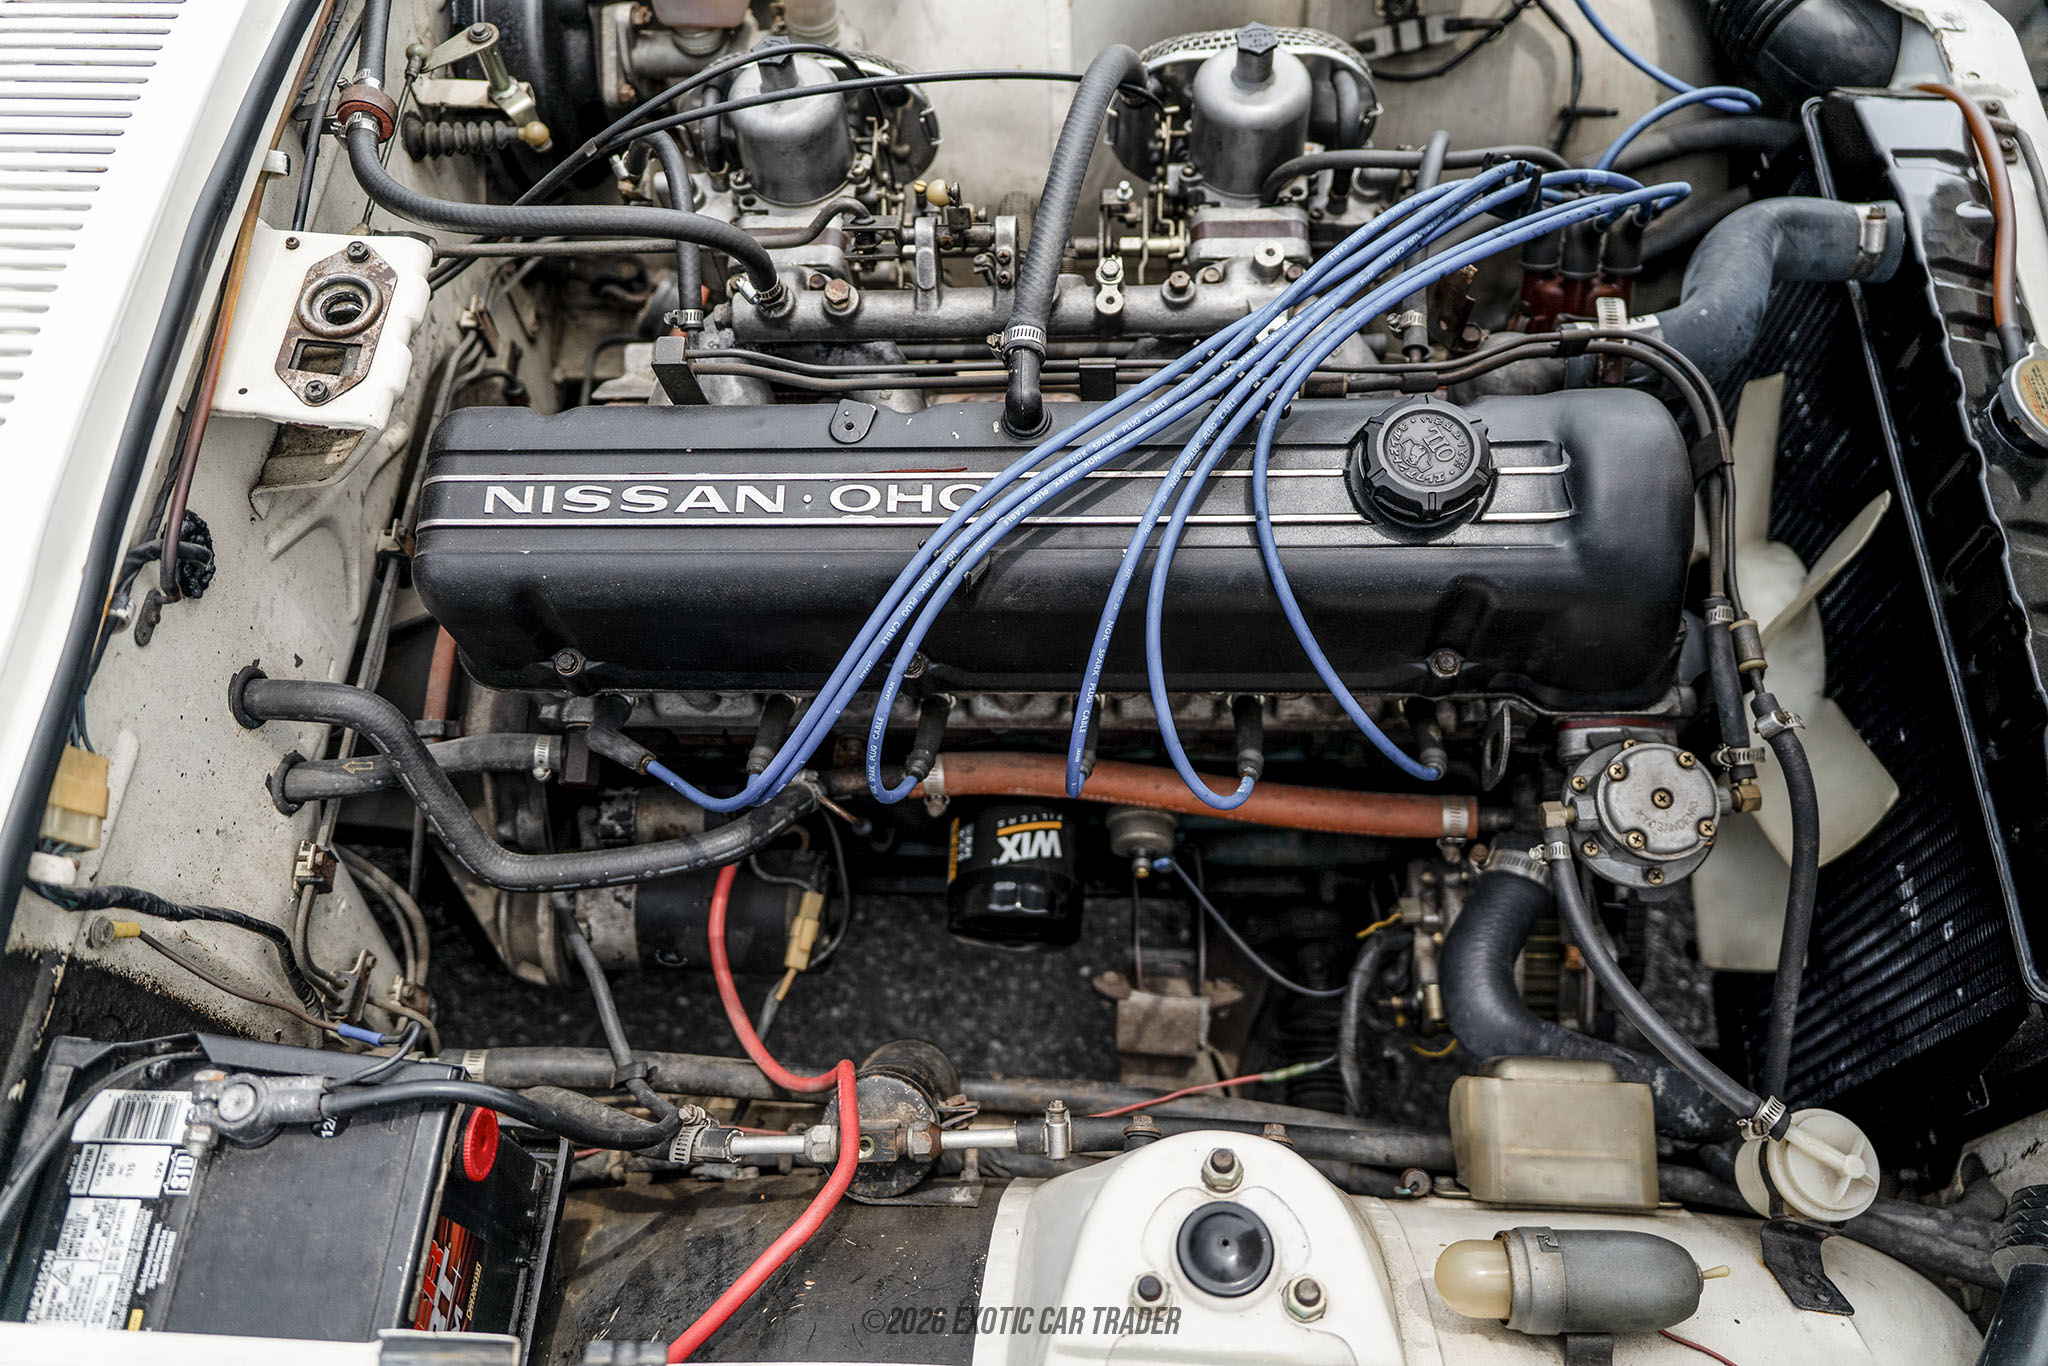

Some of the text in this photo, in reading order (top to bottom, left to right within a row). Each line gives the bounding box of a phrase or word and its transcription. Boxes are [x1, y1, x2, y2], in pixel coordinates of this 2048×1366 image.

[1327, 244, 1349, 263] CABLE
[1237, 346, 1259, 366] SPARK
[1262, 331, 1280, 347] PLUG
[1281, 313, 1304, 332] CABLE
[1068, 449, 1089, 466] NGK
[1092, 431, 1119, 451] SPARK
[1120, 416, 1141, 433] PLUG
[1145, 398, 1170, 418] CABLE
[1180, 376, 1199, 393] JAPAN
[1168, 469, 1185, 490] NGK
[1183, 441, 1202, 467] SPARK
[1202, 421, 1219, 441] PLUG
[1218, 397, 1239, 420] CABLE
[1423, 425, 1457, 463] OIL
[1083, 453, 1102, 469] NGK
[1053, 468, 1079, 488] SPARK
[483, 484, 786, 515] NISSAN
[1029, 488, 1050, 505] PLUG
[1002, 505, 1027, 528] CABLE
[941, 546, 960, 566] NGK
[918, 568, 941, 594] SPARK
[901, 596, 919, 618] PLUG
[880, 620, 901, 646] CABLE
[1102, 619, 1115, 642] NGK
[858, 659, 874, 680] JAPAN
[1091, 648, 1106, 677] SPARK
[883, 680, 896, 702] JAPAN
[1085, 682, 1097, 704] PLUG
[872, 715, 885, 740] CABLE
[1079, 709, 1091, 734] CABLE
[868, 744, 878, 763] PLUG
[996, 812, 1064, 828] FILTERS
[996, 829, 1063, 865] WIX
